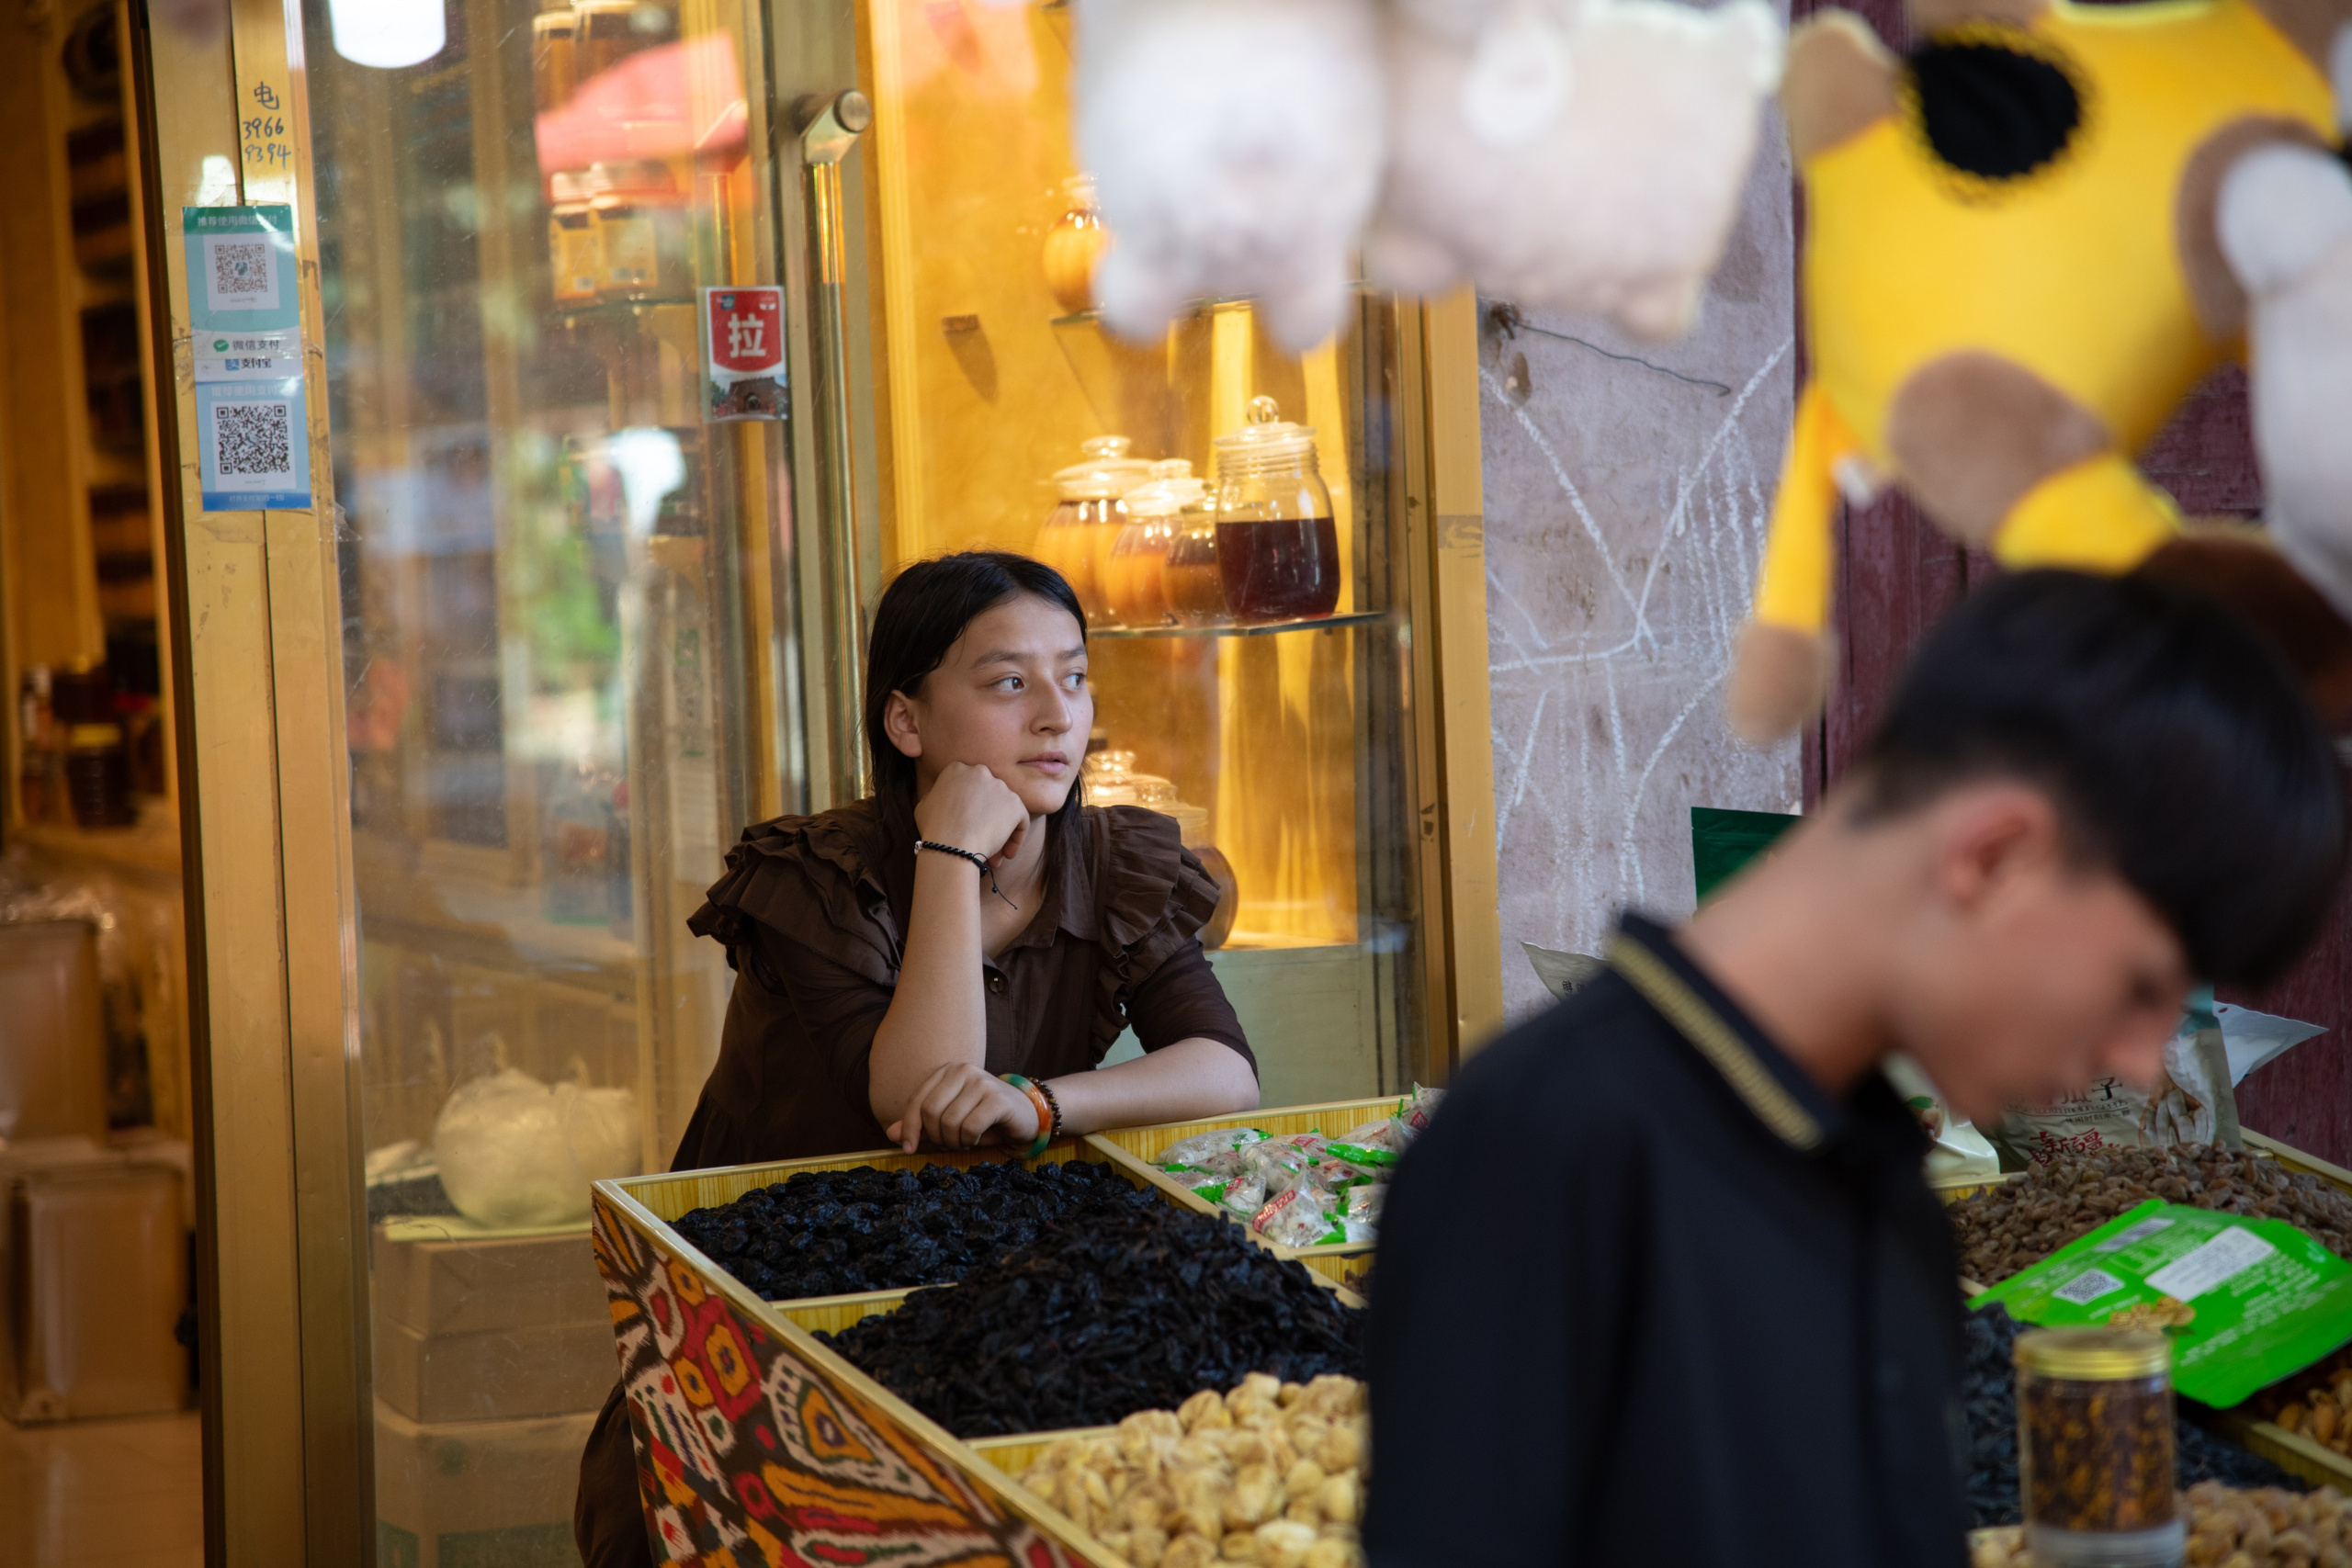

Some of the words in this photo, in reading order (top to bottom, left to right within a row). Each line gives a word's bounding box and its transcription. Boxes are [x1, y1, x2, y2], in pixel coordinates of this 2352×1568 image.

[254, 81, 279, 110] 电
[243, 117, 284, 140] 3966
[244, 143, 291, 170] 9394
[198, 214, 277, 227] 推荐使用微信付
[728, 312, 766, 358] 拉
[232, 339, 279, 351] 微信支付
[241, 358, 272, 369] 支付宝
[211, 385, 288, 398] 推荐使用支付
